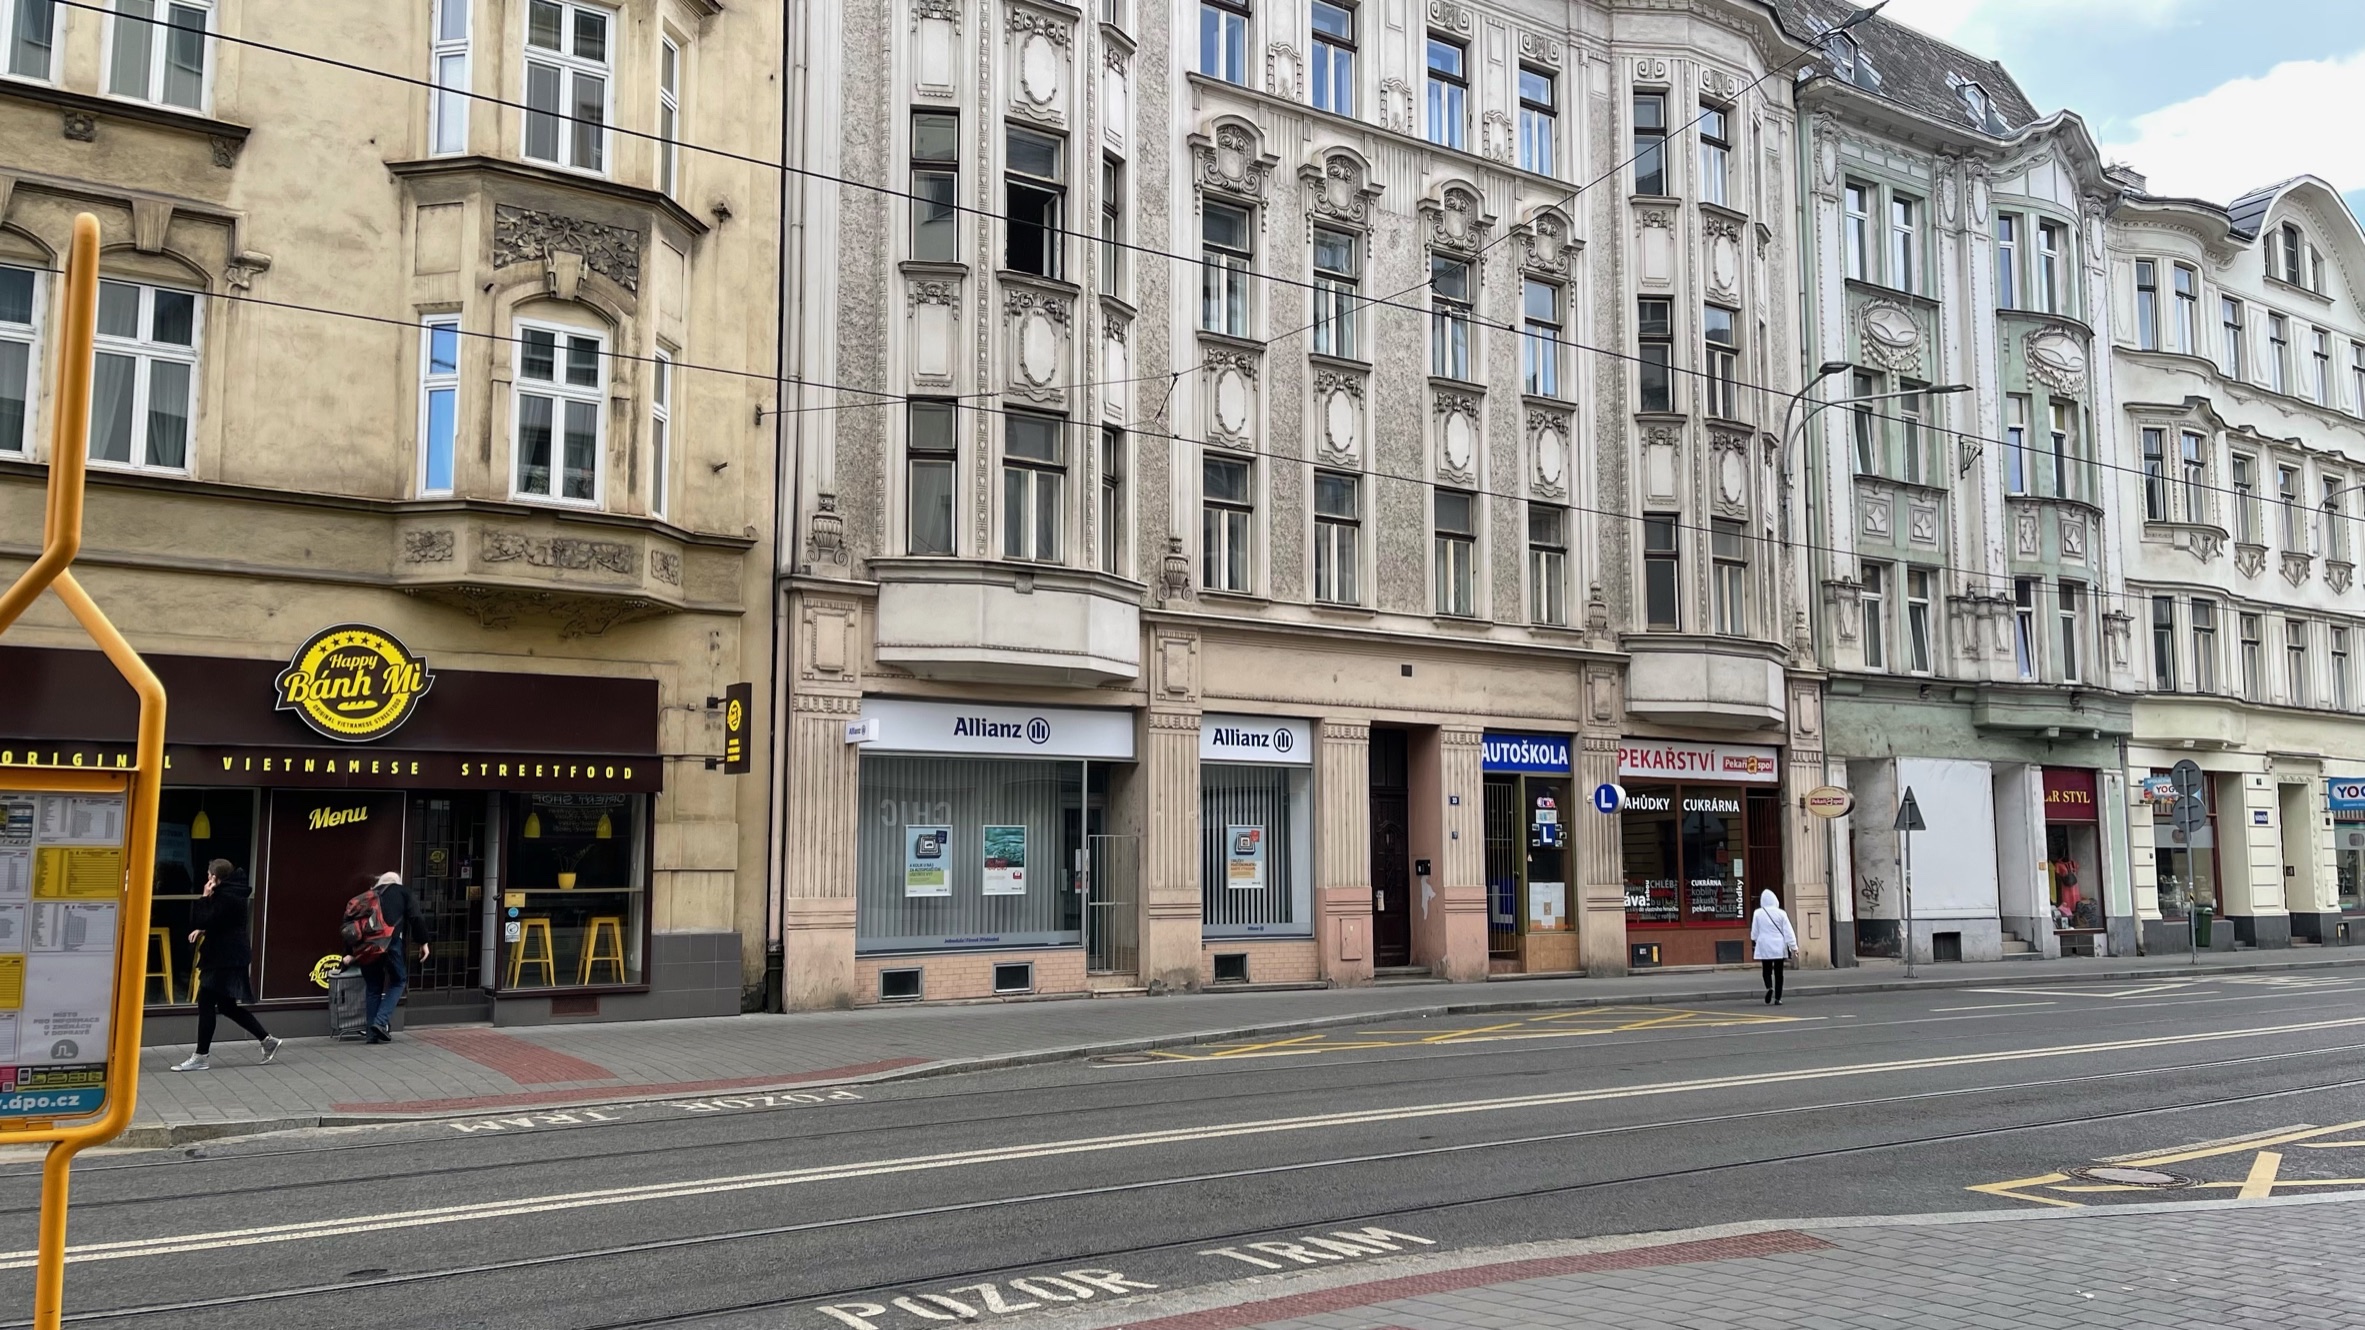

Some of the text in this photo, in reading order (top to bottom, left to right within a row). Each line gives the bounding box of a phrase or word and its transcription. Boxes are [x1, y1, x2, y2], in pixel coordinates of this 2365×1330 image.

[329, 653, 379, 671] Happy
[283, 668, 372, 703] Bánh
[312, 698, 402, 729] ORIGINAL VIETNAMESE STREETFOOD
[953, 716, 1022, 739] Allianz
[1212, 728, 1270, 747] Allianz
[1481, 739, 1569, 765] AUTOŠKOLA
[1618, 746, 1716, 772] PEKAŘSTVÍ
[1, 751, 633, 780] ORIGINL VIETNAMESE STREETFOOD
[1757, 759, 1773, 772] spol
[1601, 788, 1613, 809] L
[1623, 793, 1741, 813] AHŮDKY CUKRÁRNA
[2062, 790, 2091, 804] STYL
[308, 806, 368, 830] Menu
[1542, 826, 1553, 843] L
[1650, 877, 1674, 889] CHLÉB
[1691, 878, 1722, 887] CUKRÁRNA
[1624, 891, 1646, 907] áva
[1692, 904, 1715, 914] pekárna
[1736, 879, 1744, 918] lahůdky
[449, 1111, 622, 1134] TRAM
[1200, 1226, 1437, 1270] TRAM
[815, 1267, 1159, 1330] POZOR
